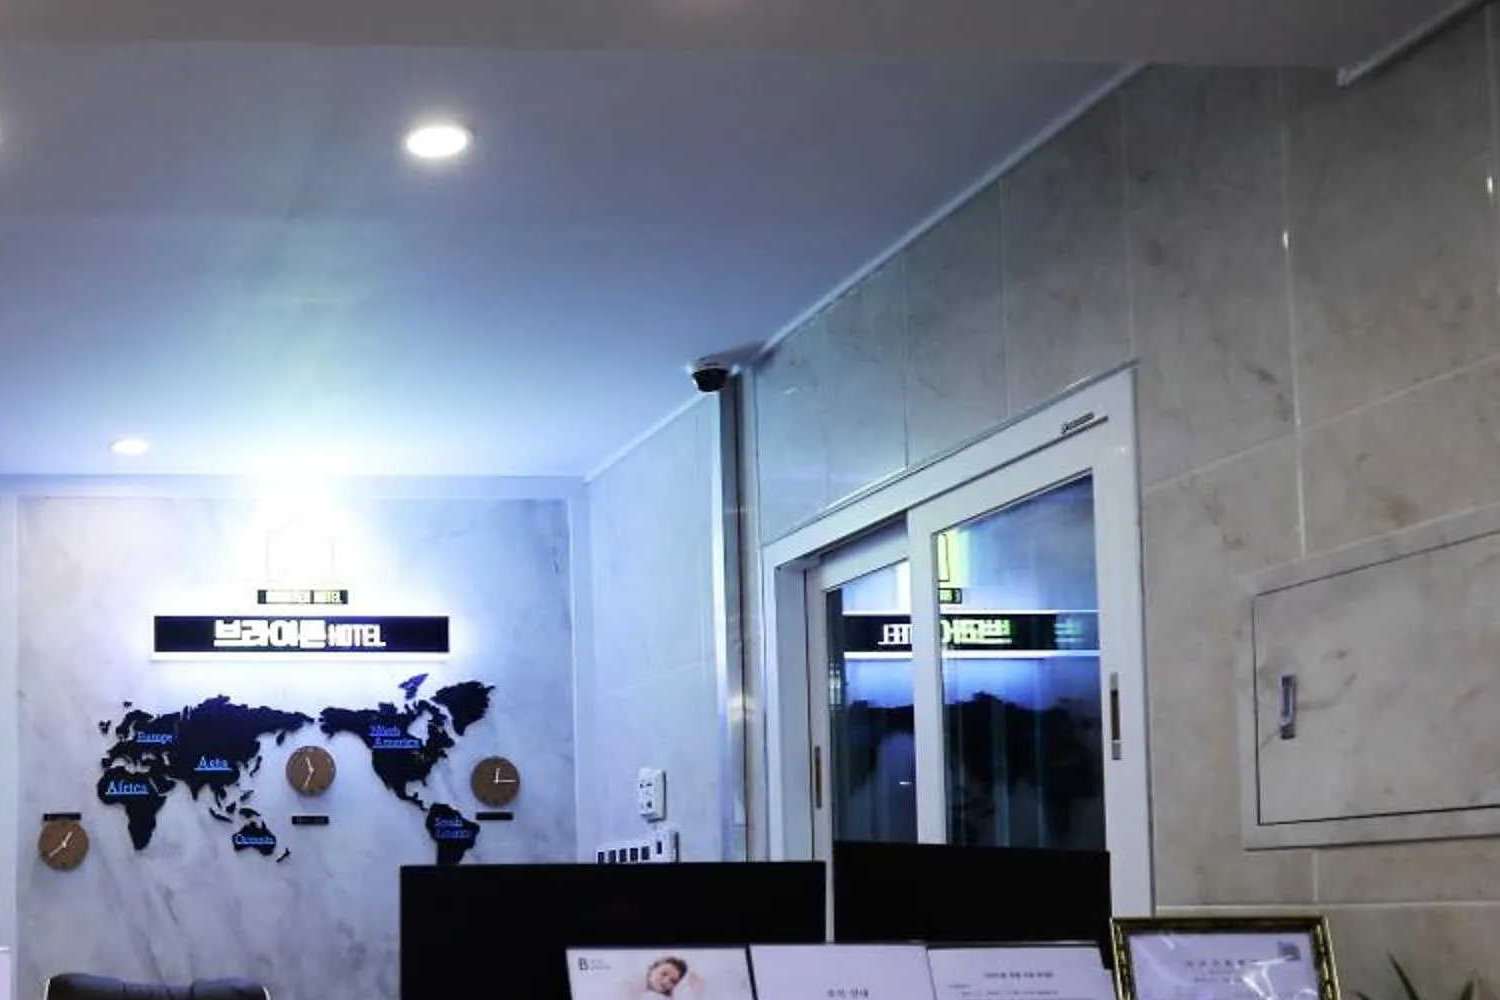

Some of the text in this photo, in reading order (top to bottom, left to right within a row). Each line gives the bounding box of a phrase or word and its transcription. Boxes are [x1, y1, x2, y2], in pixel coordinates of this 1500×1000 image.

[213, 619, 387, 648] 브라이튼 HOTEL
[195, 756, 231, 771] Asia
[106, 780, 149, 795] Africa
